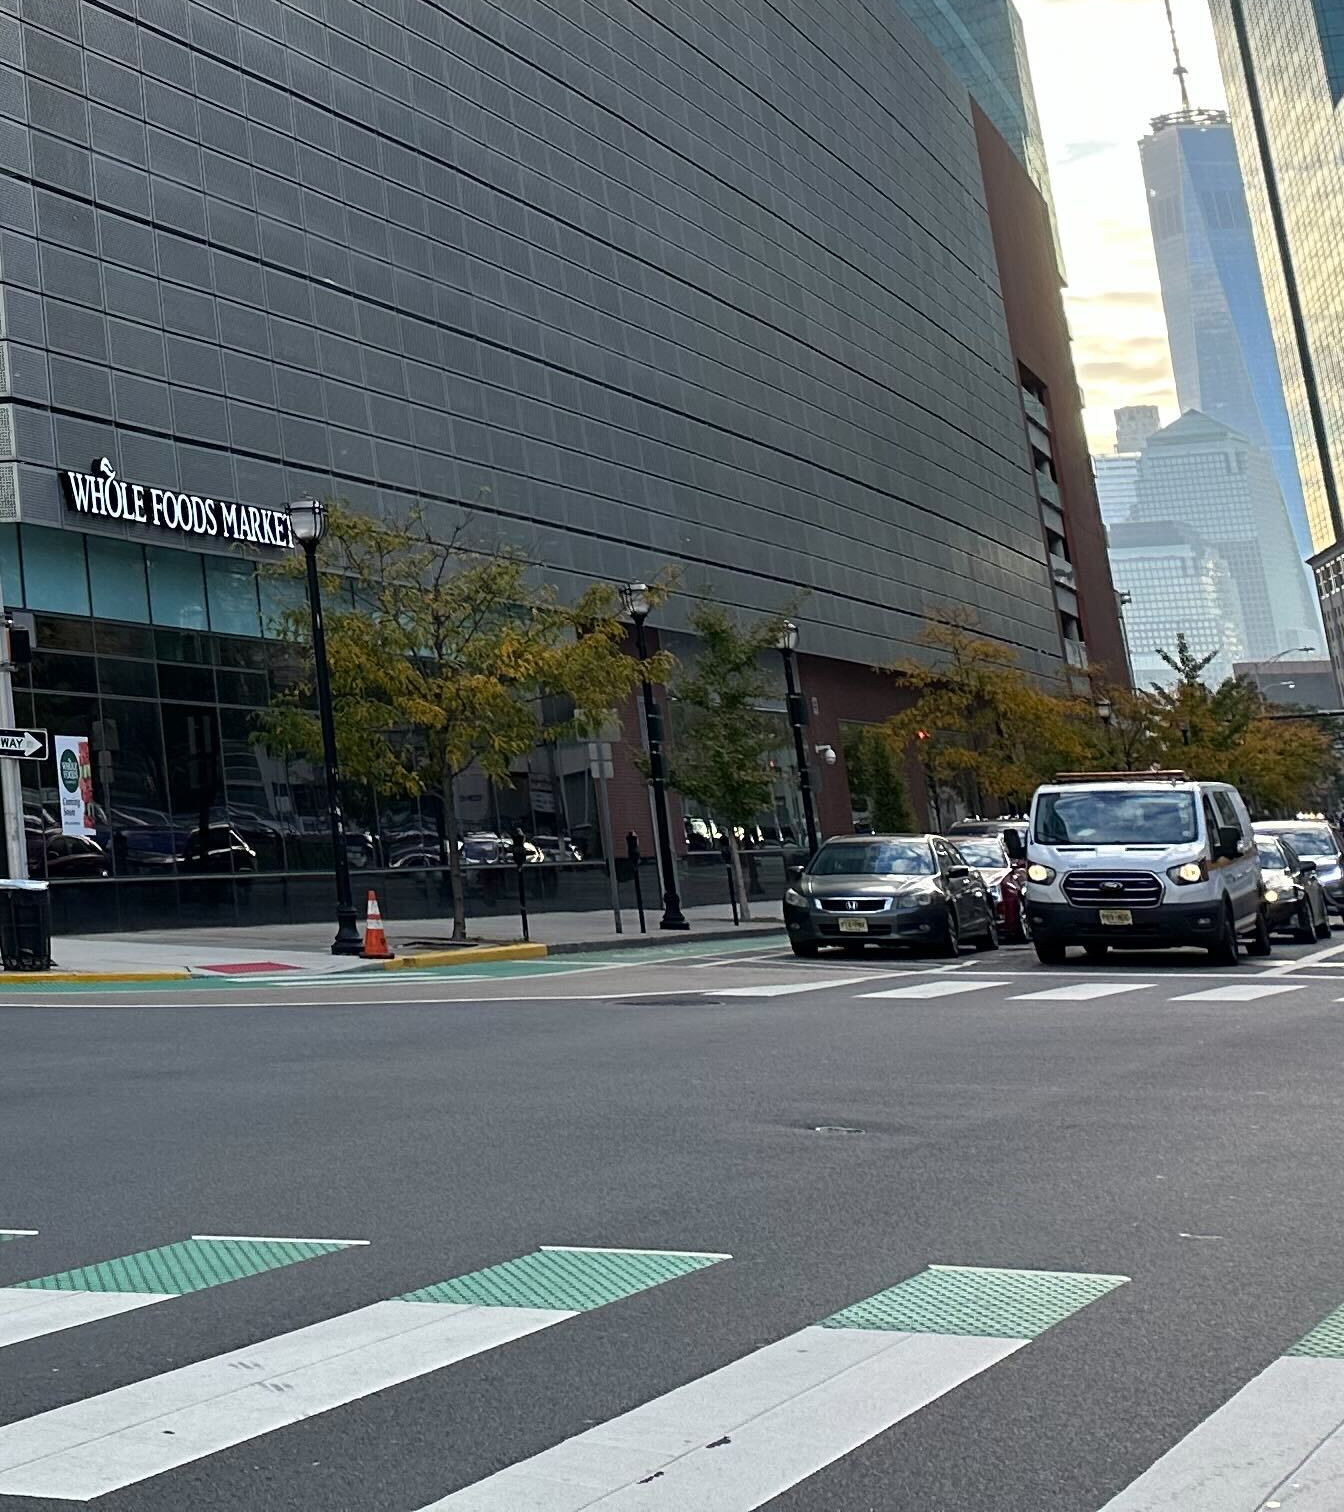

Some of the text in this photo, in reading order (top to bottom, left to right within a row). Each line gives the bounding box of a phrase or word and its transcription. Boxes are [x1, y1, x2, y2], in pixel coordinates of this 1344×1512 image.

[67, 457, 295, 548] WHOLE FOODS MARKET
[0, 737, 24, 749] WAY
